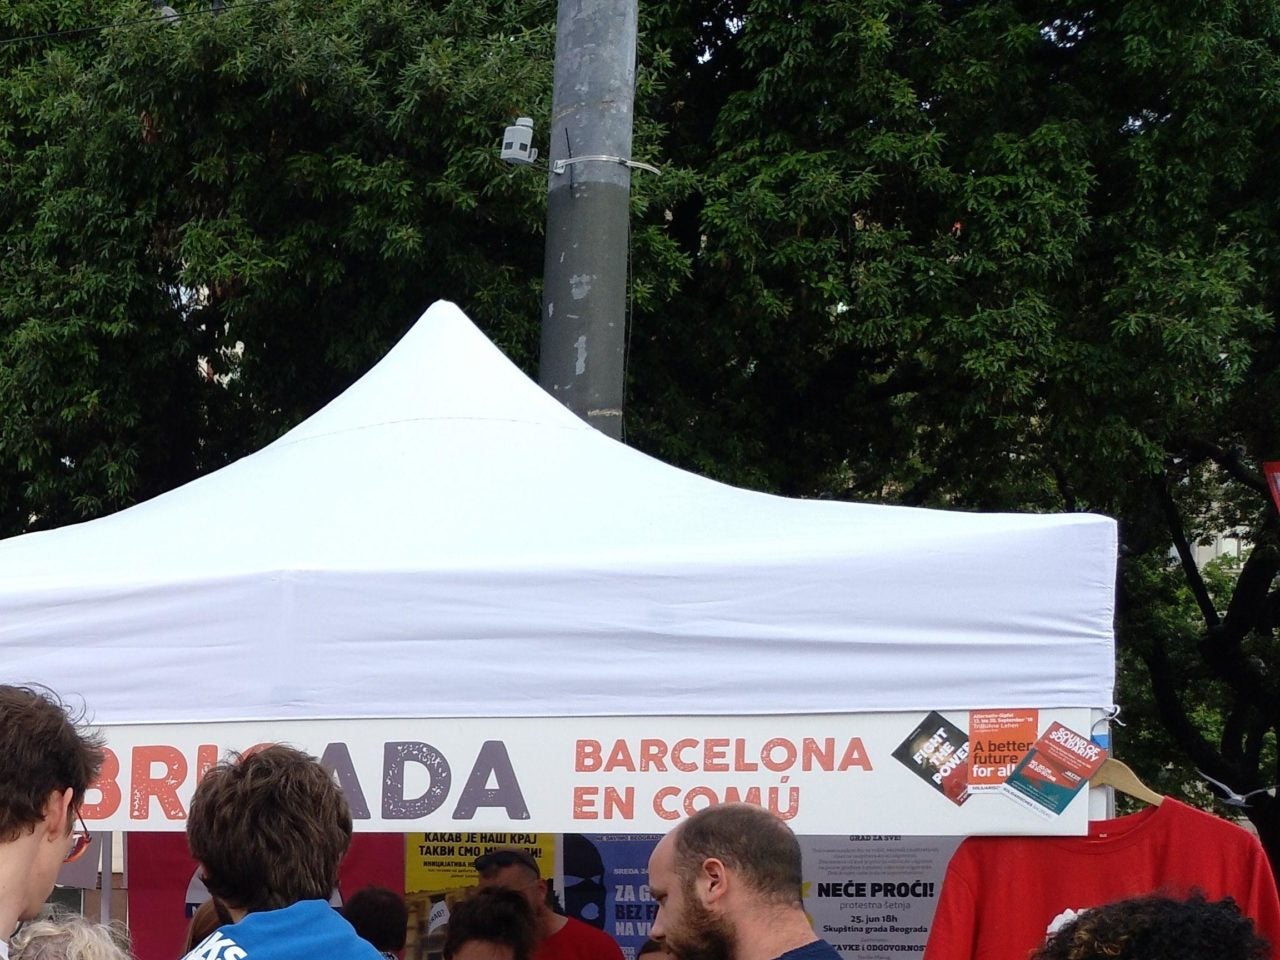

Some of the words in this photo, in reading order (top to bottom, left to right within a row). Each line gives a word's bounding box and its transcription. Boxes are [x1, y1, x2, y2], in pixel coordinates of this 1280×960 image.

[912, 727, 948, 765] FIGHT
[973, 741, 984, 752] A
[988, 740, 1034, 753] better
[1049, 731, 1100, 762] SOLIDARITY
[1059, 727, 1088, 748] SOUND
[1086, 744, 1101, 756] OF
[575, 737, 873, 772] BARCELONA
[929, 741, 955, 766] THE
[973, 752, 1018, 765] future
[972, 764, 995, 777] for
[77, 740, 530, 820] BRIADA
[573, 786, 635, 820] EN
[425, 832, 462, 843] КАКАВ
[480, 833, 506, 844] НАШ
[510, 833, 537, 845] КРАЈ
[419, 845, 455, 856] ТАКВИ
[458, 846, 480, 857] СМО
[615, 885, 635, 902] ZA
[639, 885, 656, 902] G
[615, 904, 643, 920] BEZ
[840, 901, 882, 911] protestna
[884, 901, 911, 911] šetnja
[866, 915, 880, 924] jun
[882, 915, 898, 923] 18h
[615, 922, 635, 936] NA
[823, 924, 863, 934] Skupština
[865, 926, 888, 935] grada
[889, 925, 928, 934] Beograda
